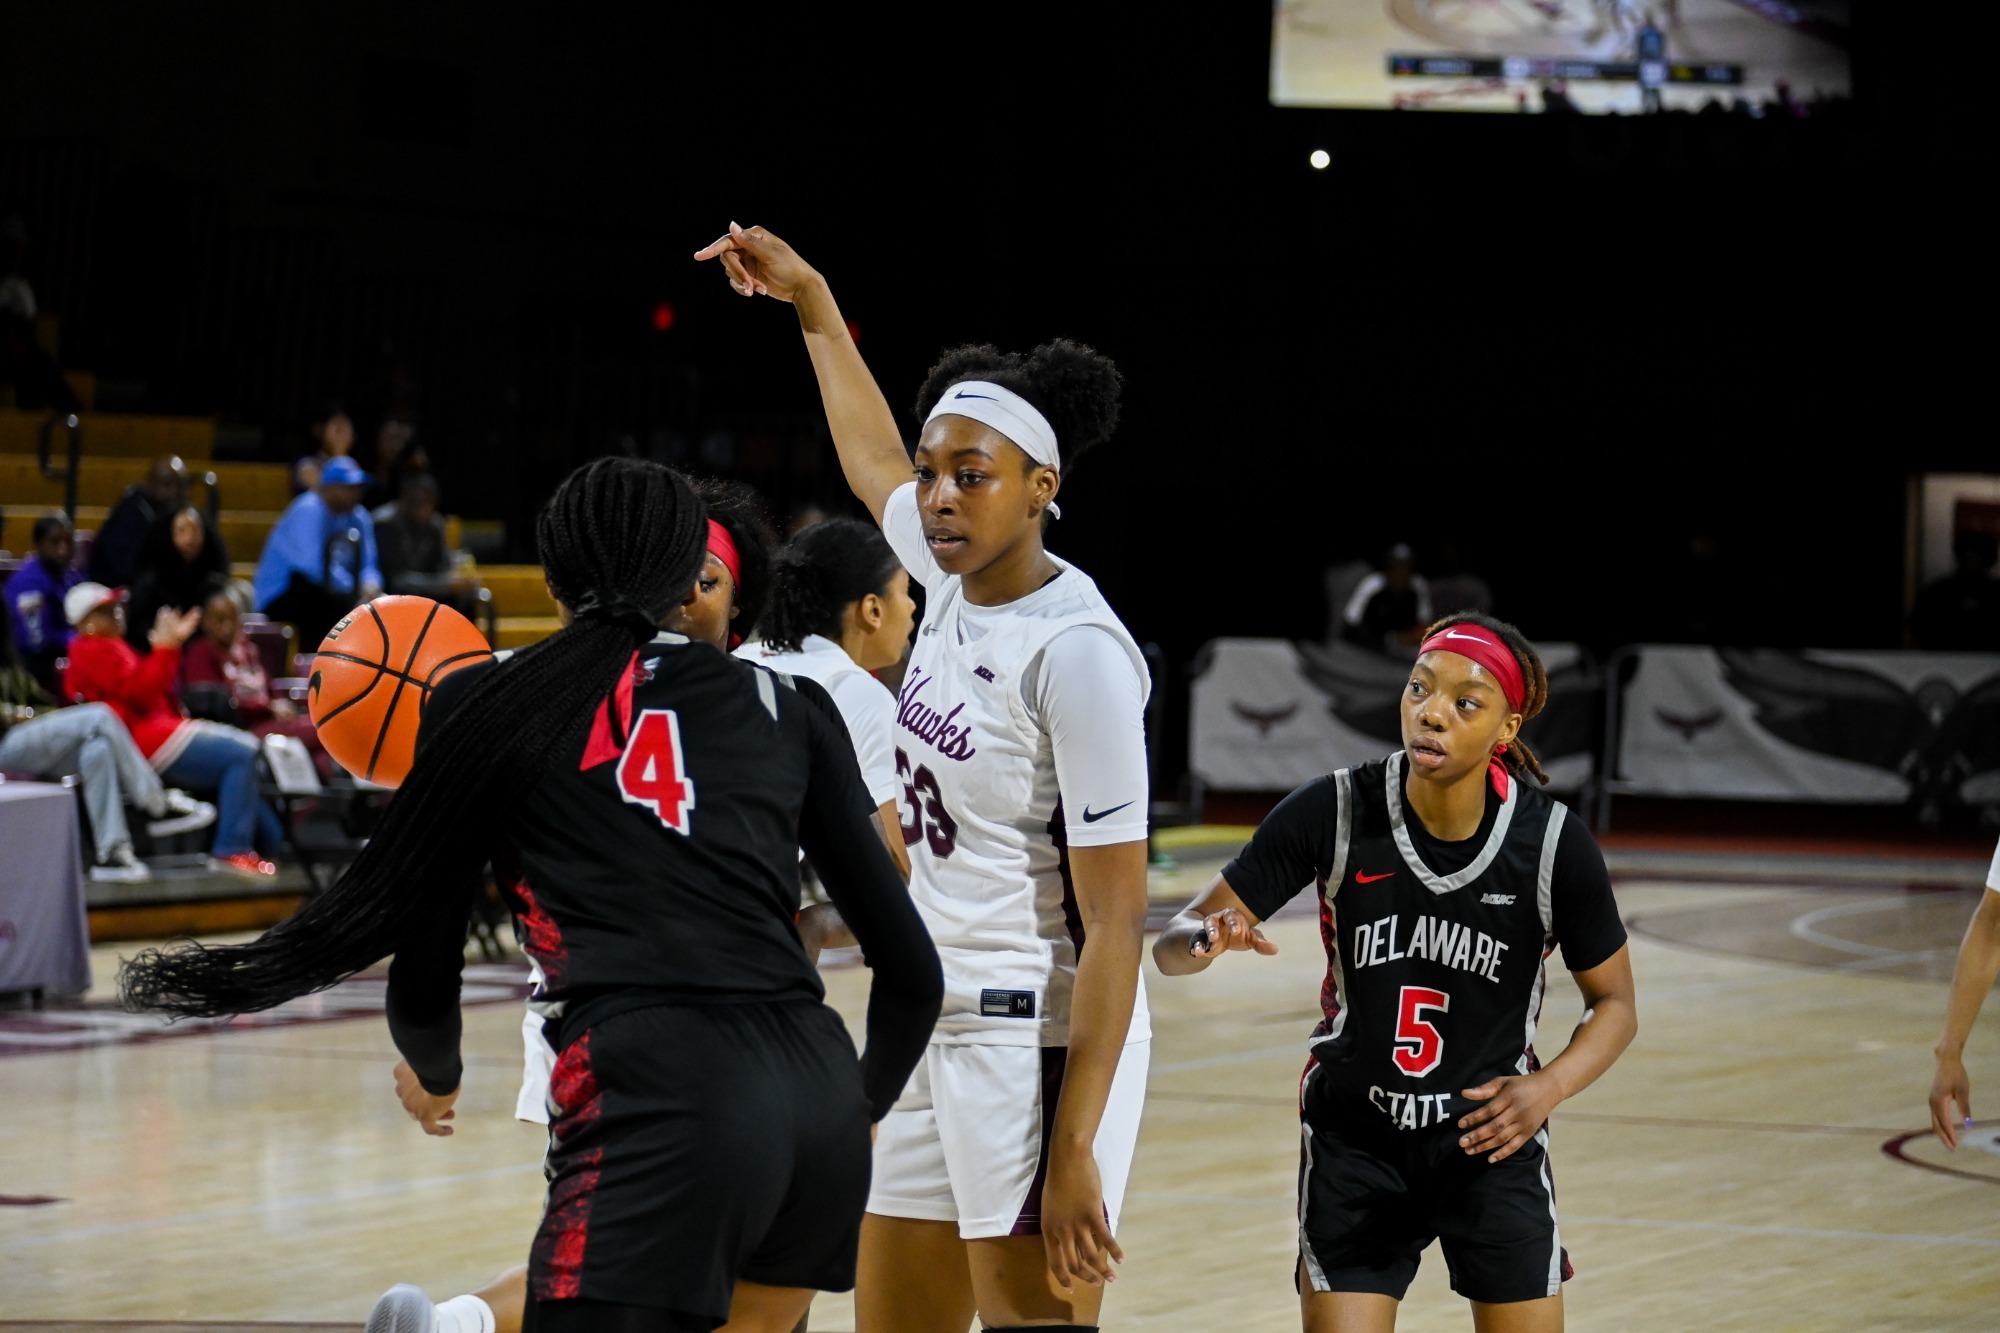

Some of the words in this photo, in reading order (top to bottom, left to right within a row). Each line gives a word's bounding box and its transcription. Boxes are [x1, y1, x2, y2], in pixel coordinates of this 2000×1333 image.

[895, 666, 976, 761] Hawks
[616, 709, 695, 835] 4
[1354, 914, 1509, 983] DELAWARE
[1017, 998, 1027, 1010] M
[1392, 985, 1450, 1078] 5
